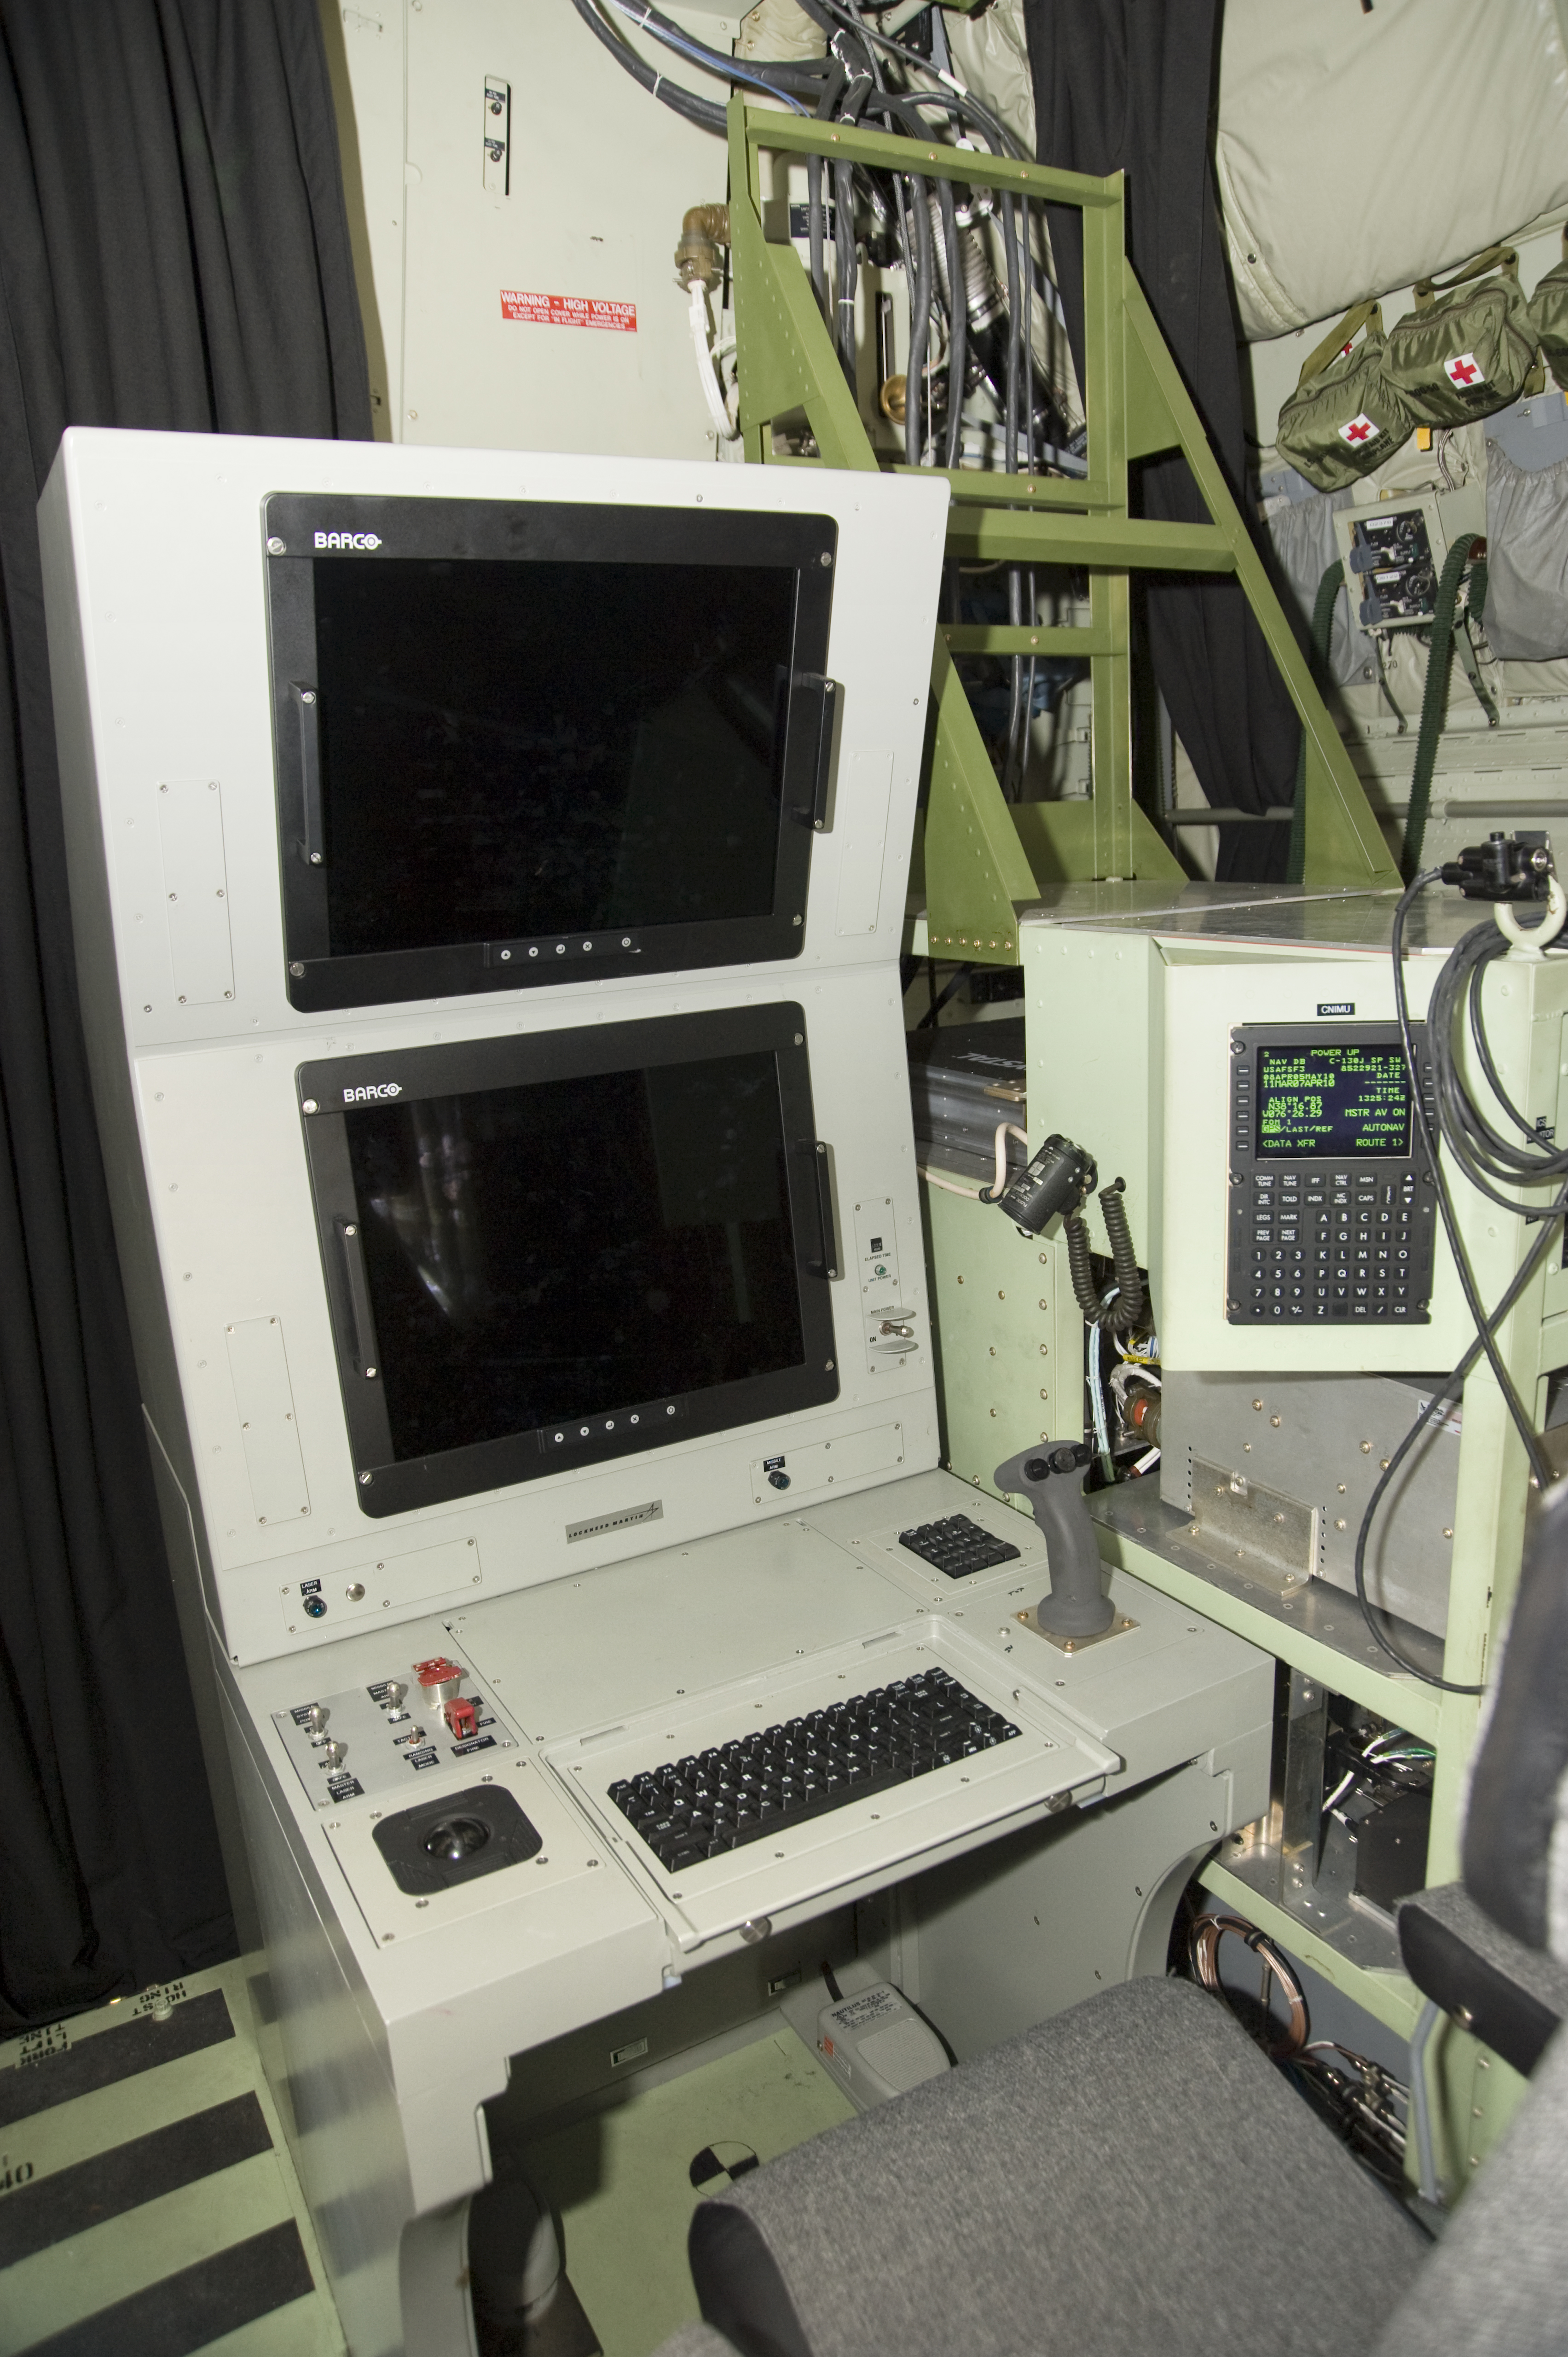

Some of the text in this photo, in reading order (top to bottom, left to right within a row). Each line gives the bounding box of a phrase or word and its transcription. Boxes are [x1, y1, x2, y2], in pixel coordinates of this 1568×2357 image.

[501, 291, 550, 307] WARNING
[563, 298, 589, 311] HIGH
[591, 301, 635, 316] VOLTAGE
[513, 312, 535, 320] EXCEPT
[585, 319, 625, 329] EMERGENCIES
[591, 313, 612, 321] POWER
[1369, 427, 1390, 447] AID KIT
[314, 531, 382, 550] BARCO
[1321, 1005, 1351, 1014] CNIMU
[1263, 1079, 1335, 1088] 11MAR07APR10
[343, 1083, 402, 1103] BARCO
[1344, 1109, 1370, 1117] MSTR
[1392, 1108, 1406, 1116] ON
[1537, 1118, 1546, 1127] ICS
[1362, 1123, 1405, 1132] AUTONAV
[1296, 1139, 1316, 1147] XFR
[1356, 1138, 1386, 1146] ROUTE
[1256, 1289, 1261, 1297] 7
[766, 1457, 782, 1465] MISSILE
[569, 1514, 643, 1538] LOCKHEED MARTIN
[301, 1580, 318, 1589] LASER
[455, 1737, 489, 1750] DESIGNATOR
[409, 1748, 433, 1758] RANGING
[331, 1780, 354, 1790] MASTER
[336, 1787, 354, 1795] LASER
[695, 1789, 708, 1798] W
[132, 1990, 186, 2016] HOST
[831, 2002, 861, 2017] NAUTILUS
